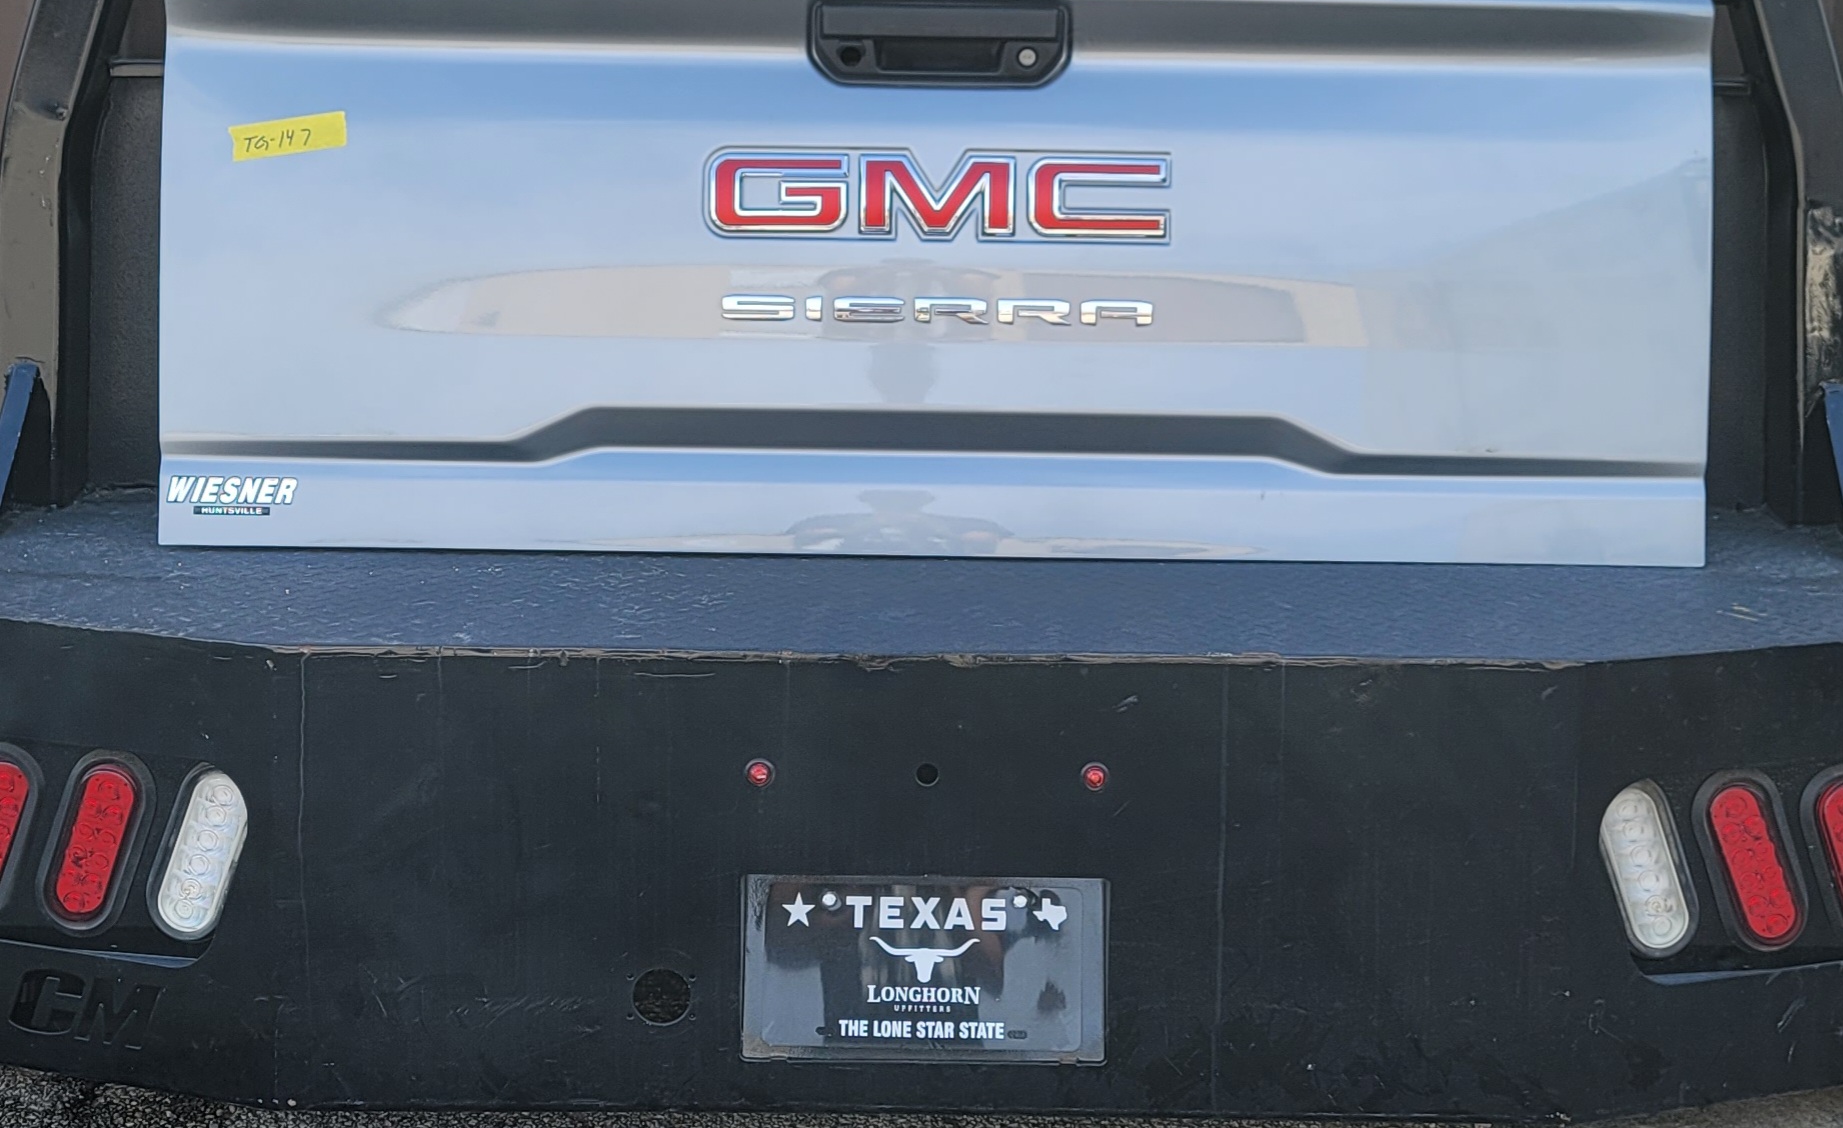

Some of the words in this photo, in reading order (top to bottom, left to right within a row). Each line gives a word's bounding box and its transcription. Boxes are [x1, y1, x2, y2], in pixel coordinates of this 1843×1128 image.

[706, 148, 1171, 242] GMC
[720, 293, 1155, 327] SIERRA
[166, 475, 299, 506] WIESNER
[200, 506, 263, 515] HUNTSVILLE
[845, 895, 1008, 932] TEXAS
[866, 984, 982, 1005] LONGHORN
[893, 1004, 952, 1014] UPFITTERS
[838, 1019, 869, 1038] THE
[873, 1020, 912, 1039] LONE
[916, 1021, 956, 1040] STAR
[959, 1021, 1006, 1040] STATE
